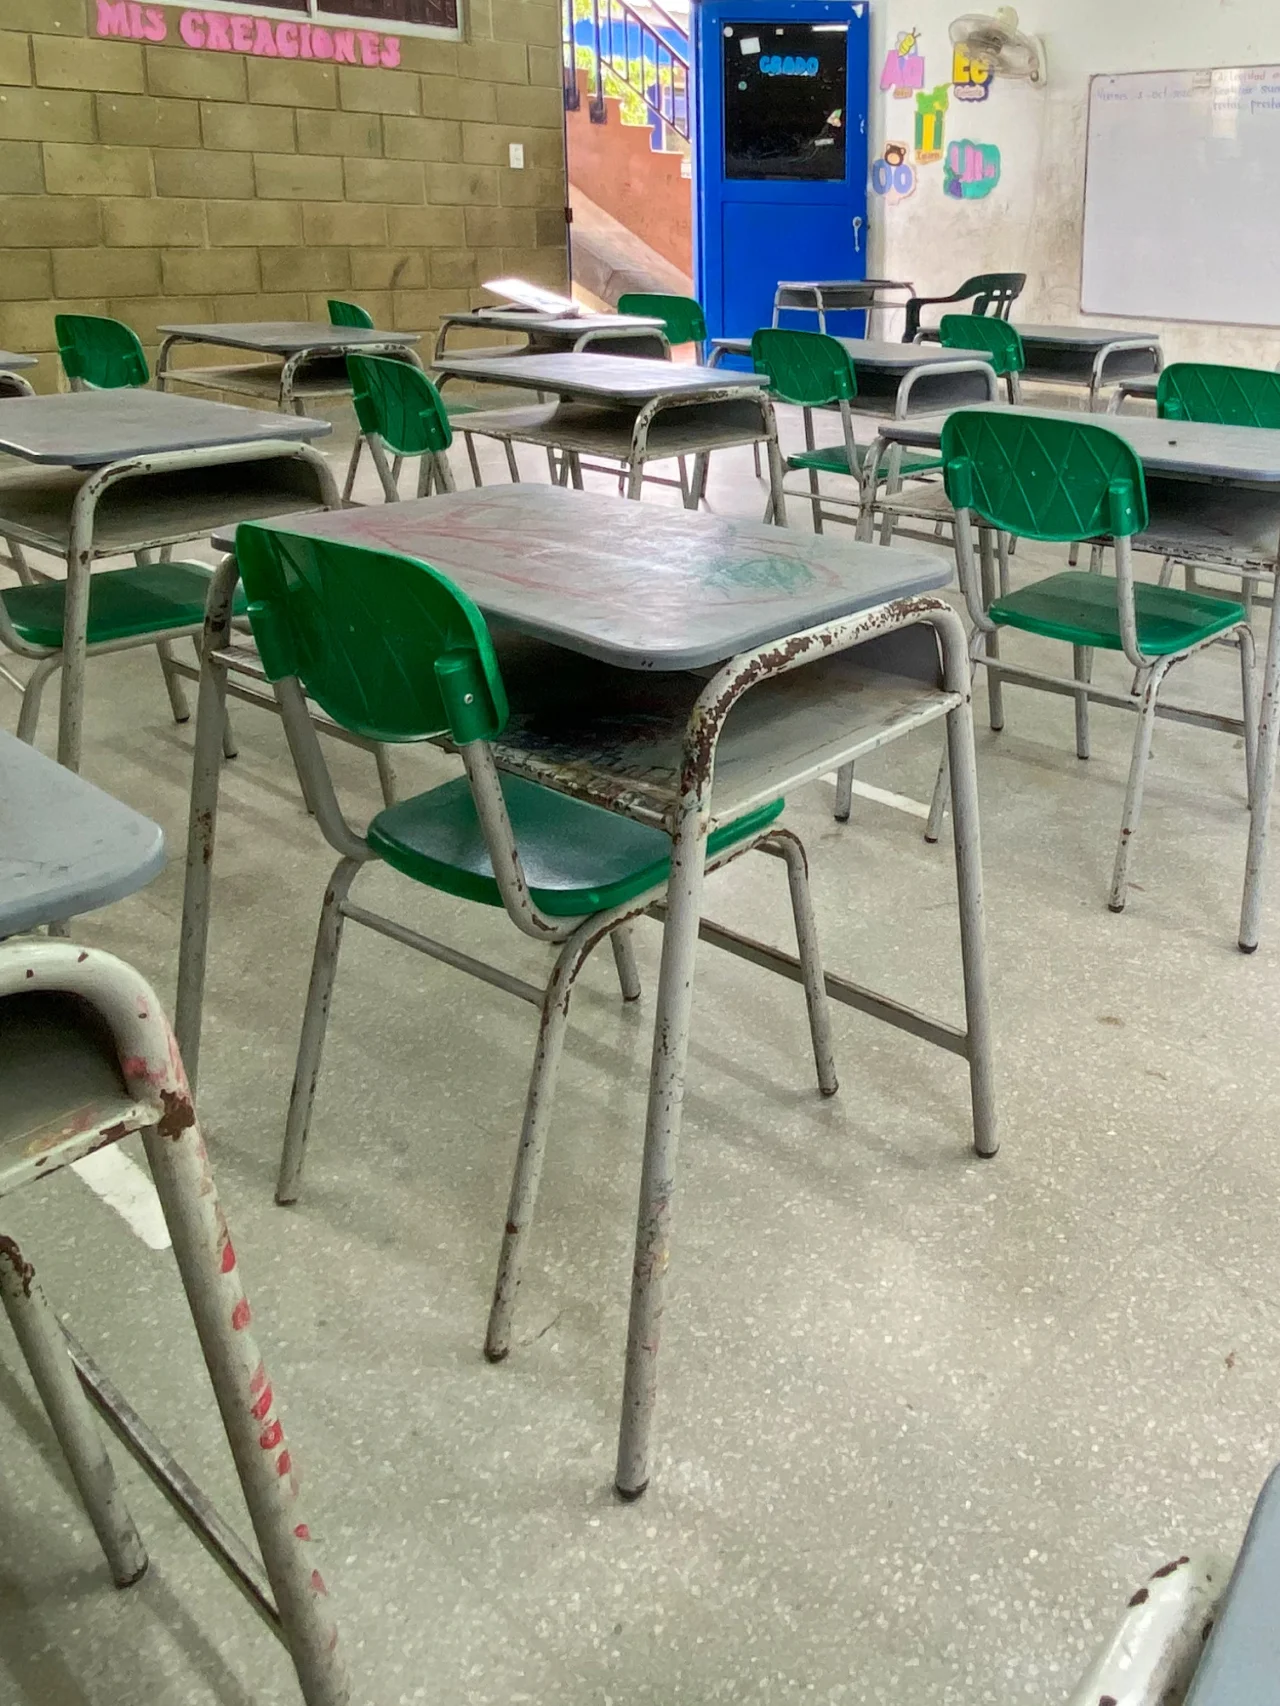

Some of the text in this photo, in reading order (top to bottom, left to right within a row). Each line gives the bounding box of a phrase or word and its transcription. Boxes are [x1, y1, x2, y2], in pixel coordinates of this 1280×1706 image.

[96, 0, 400, 68] MIS CREACIONES
[759, 55, 820, 76] GRADO
